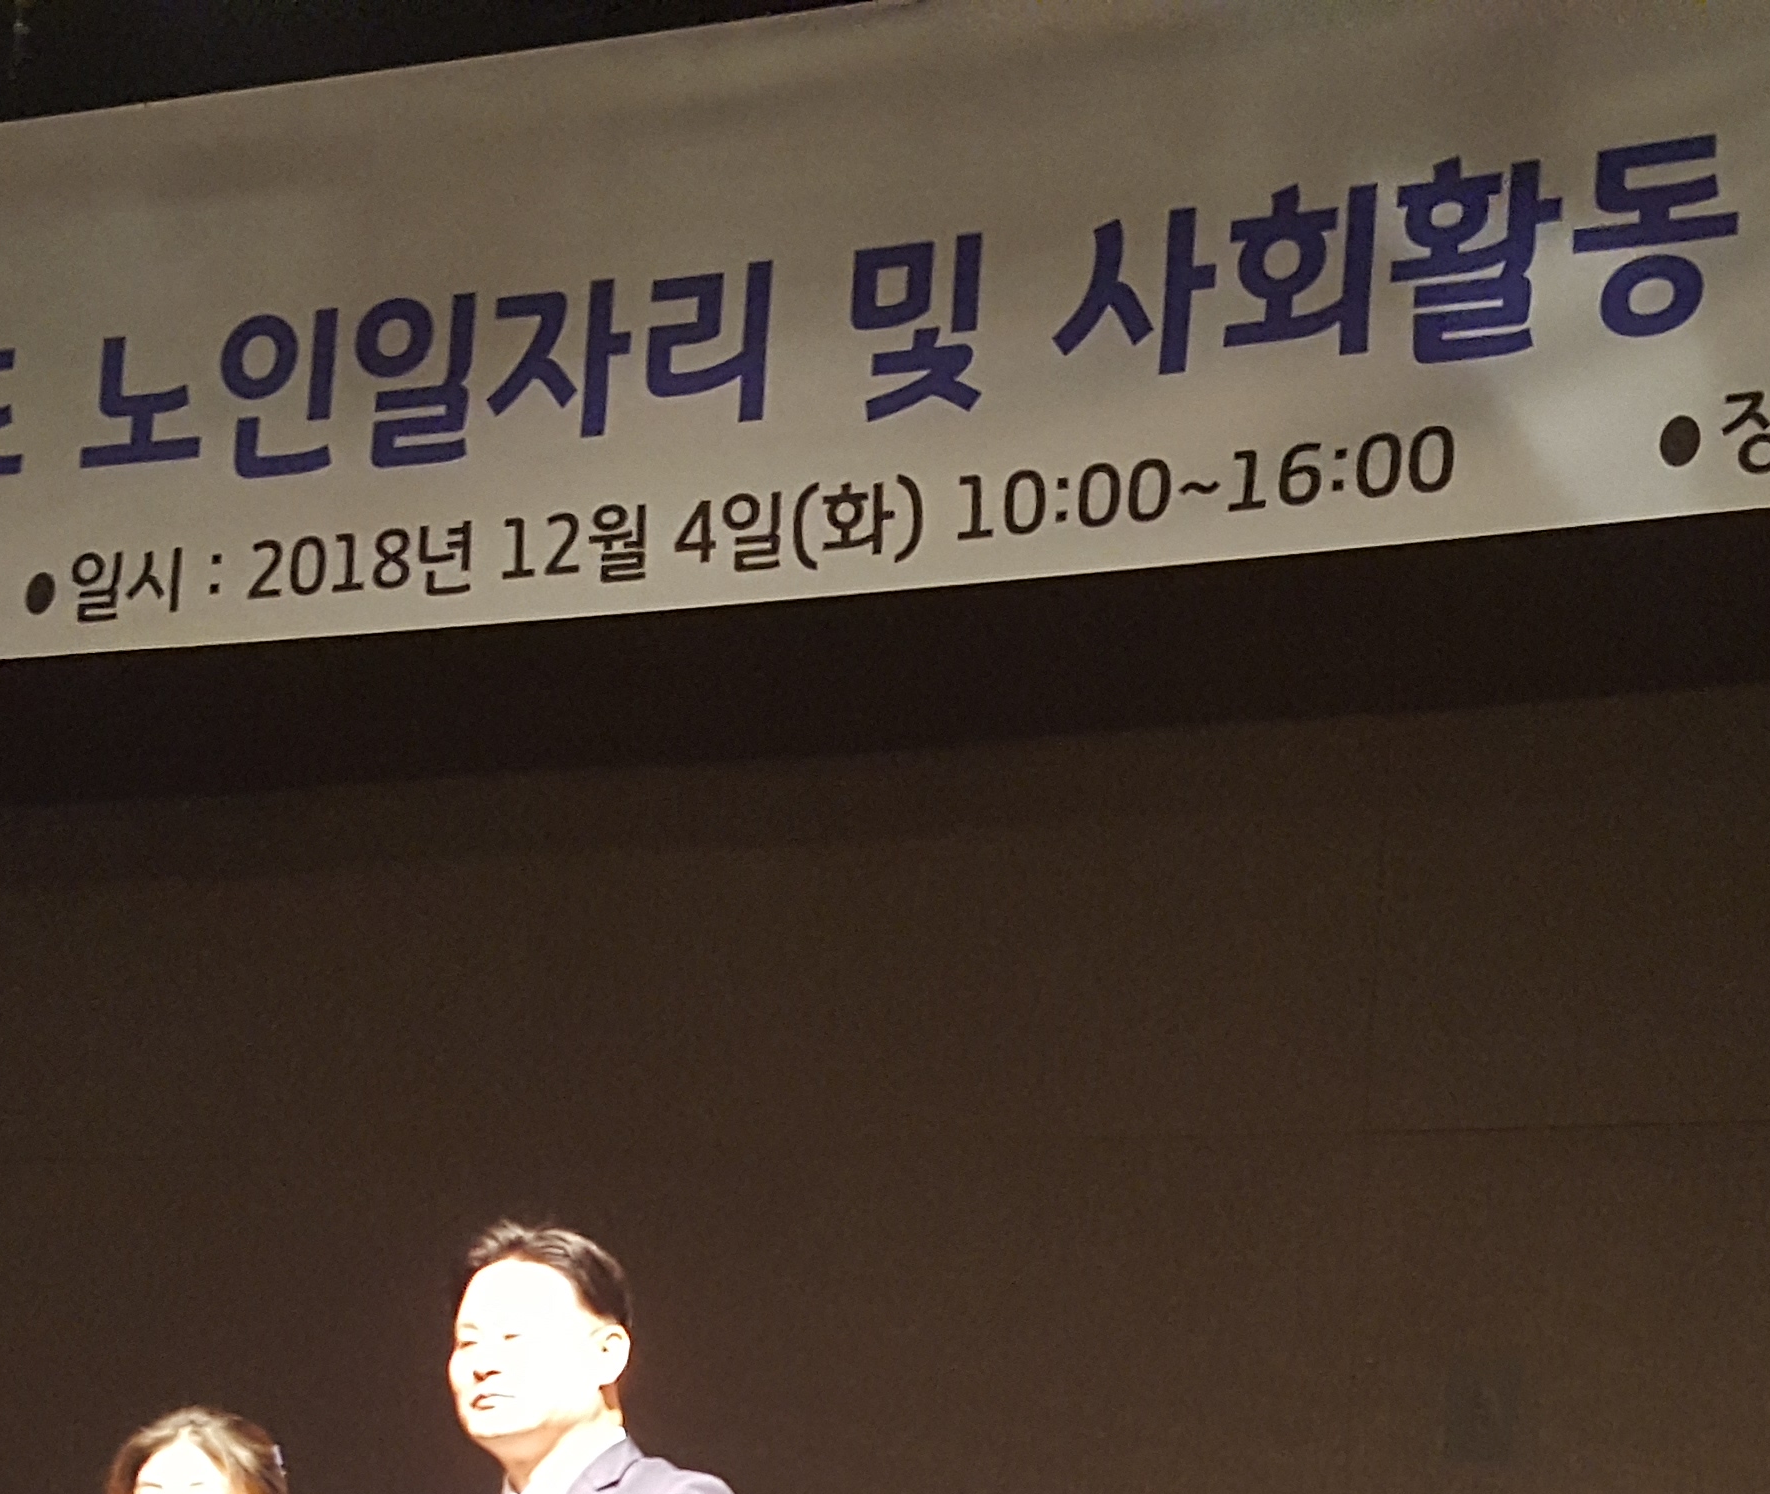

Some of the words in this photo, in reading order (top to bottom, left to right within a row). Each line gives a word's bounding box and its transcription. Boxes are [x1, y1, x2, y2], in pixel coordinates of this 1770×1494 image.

[80, 260, 774, 479] 노인일자리
[850, 231, 983, 422] 및
[1052, 134, 1740, 375] 사회활동
[246, 519, 473, 601] 2018년
[500, 502, 648, 585] 12월
[672, 473, 924, 574] 4일(화)
[955, 424, 1456, 542] 10:00~16:00
